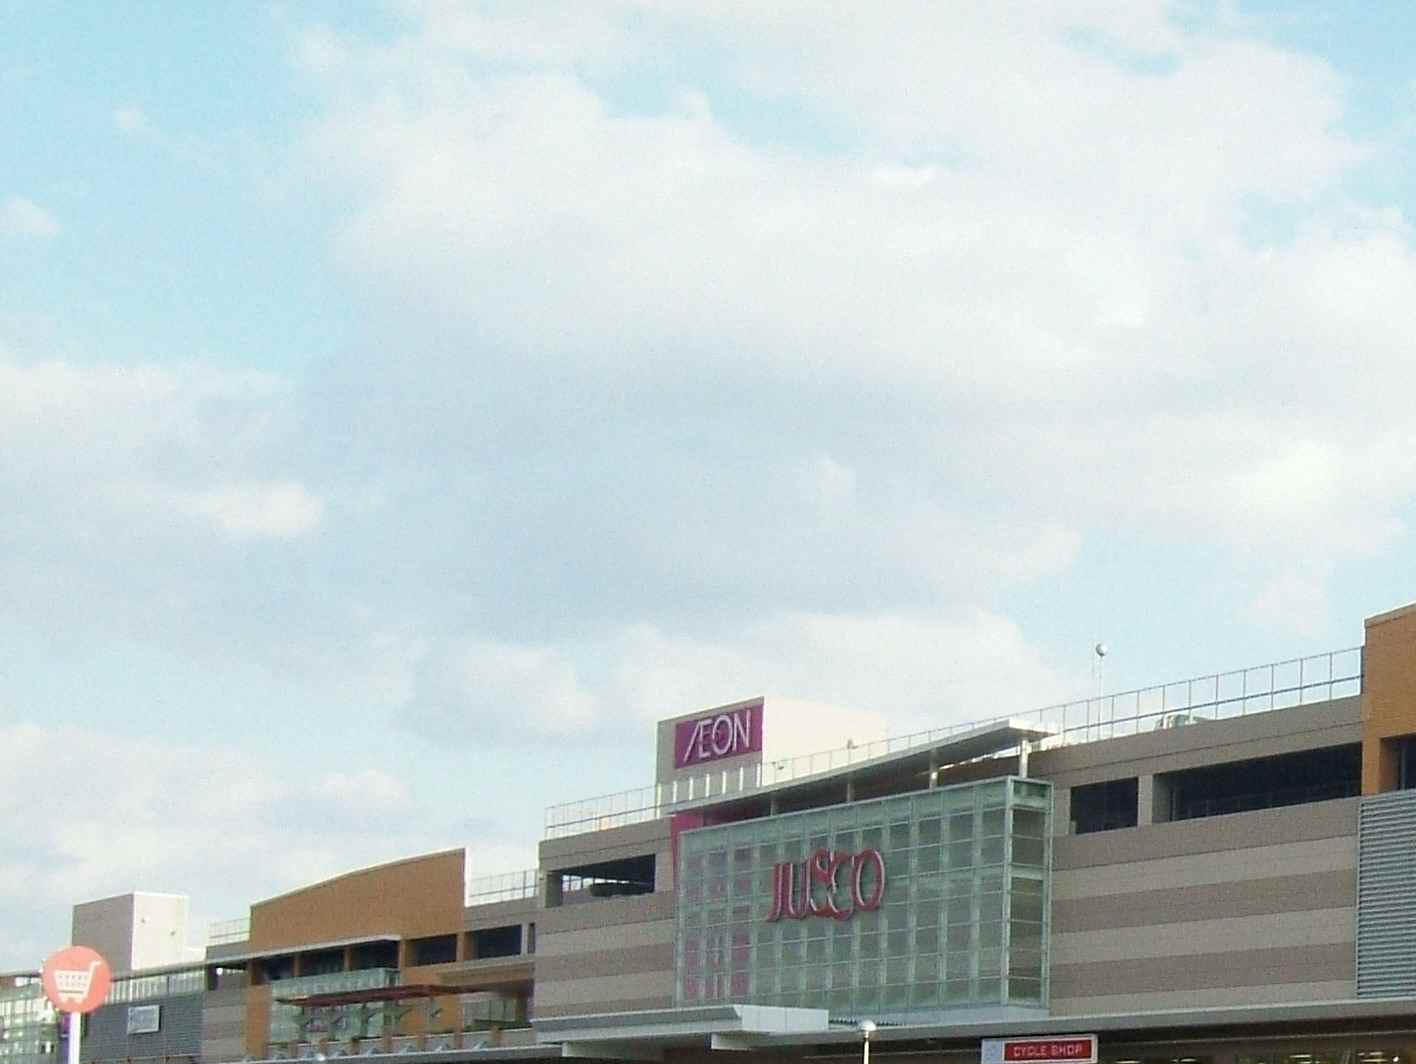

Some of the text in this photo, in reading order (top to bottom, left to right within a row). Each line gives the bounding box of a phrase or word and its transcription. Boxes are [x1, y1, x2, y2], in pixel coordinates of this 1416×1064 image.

[767, 847, 887, 923] JUSCO
[1013, 1043, 1083, 1057] CYCLE SHOP
